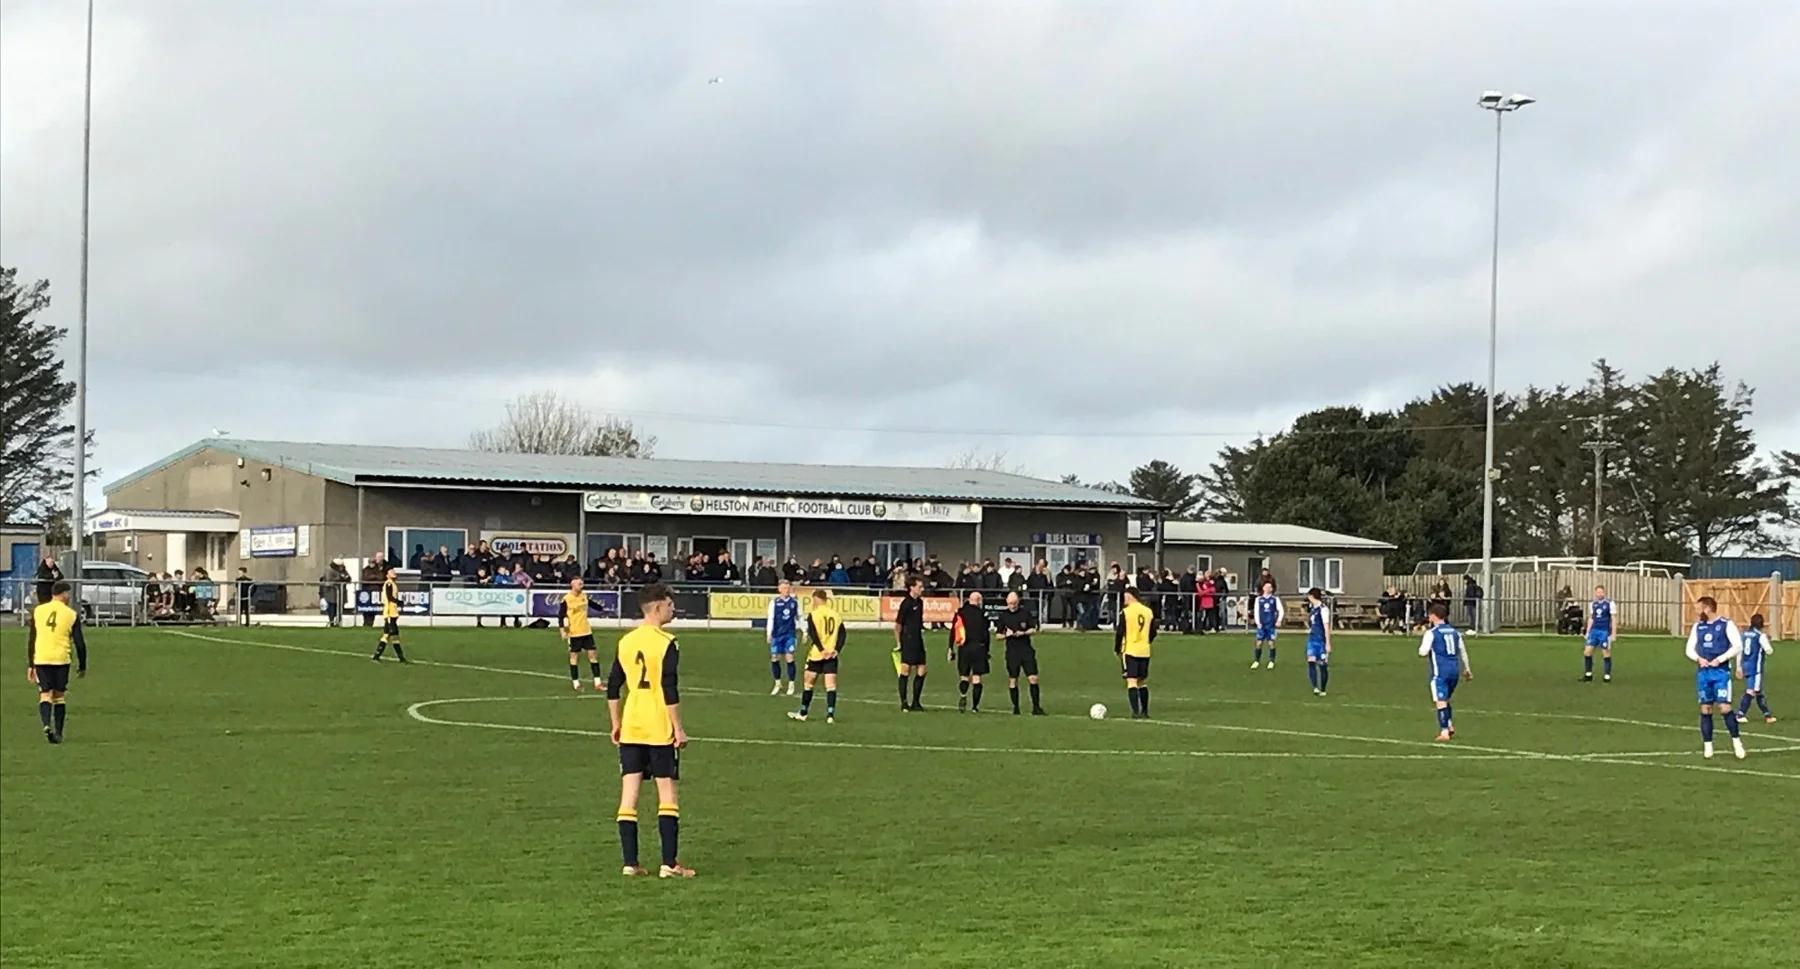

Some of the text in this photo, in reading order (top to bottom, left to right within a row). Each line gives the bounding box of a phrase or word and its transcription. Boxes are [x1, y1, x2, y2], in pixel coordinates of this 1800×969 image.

[706, 499, 871, 516] HELSTON ATHLETIC FOOTBALL CLUB
[478, 591, 514, 601] taxis
[46, 611, 57, 633] 4
[823, 616, 835, 635] 10
[1138, 614, 1145, 632] 9
[1444, 634, 1456, 655] 11
[1744, 637, 1752, 655] 8
[635, 650, 651, 689] 2
